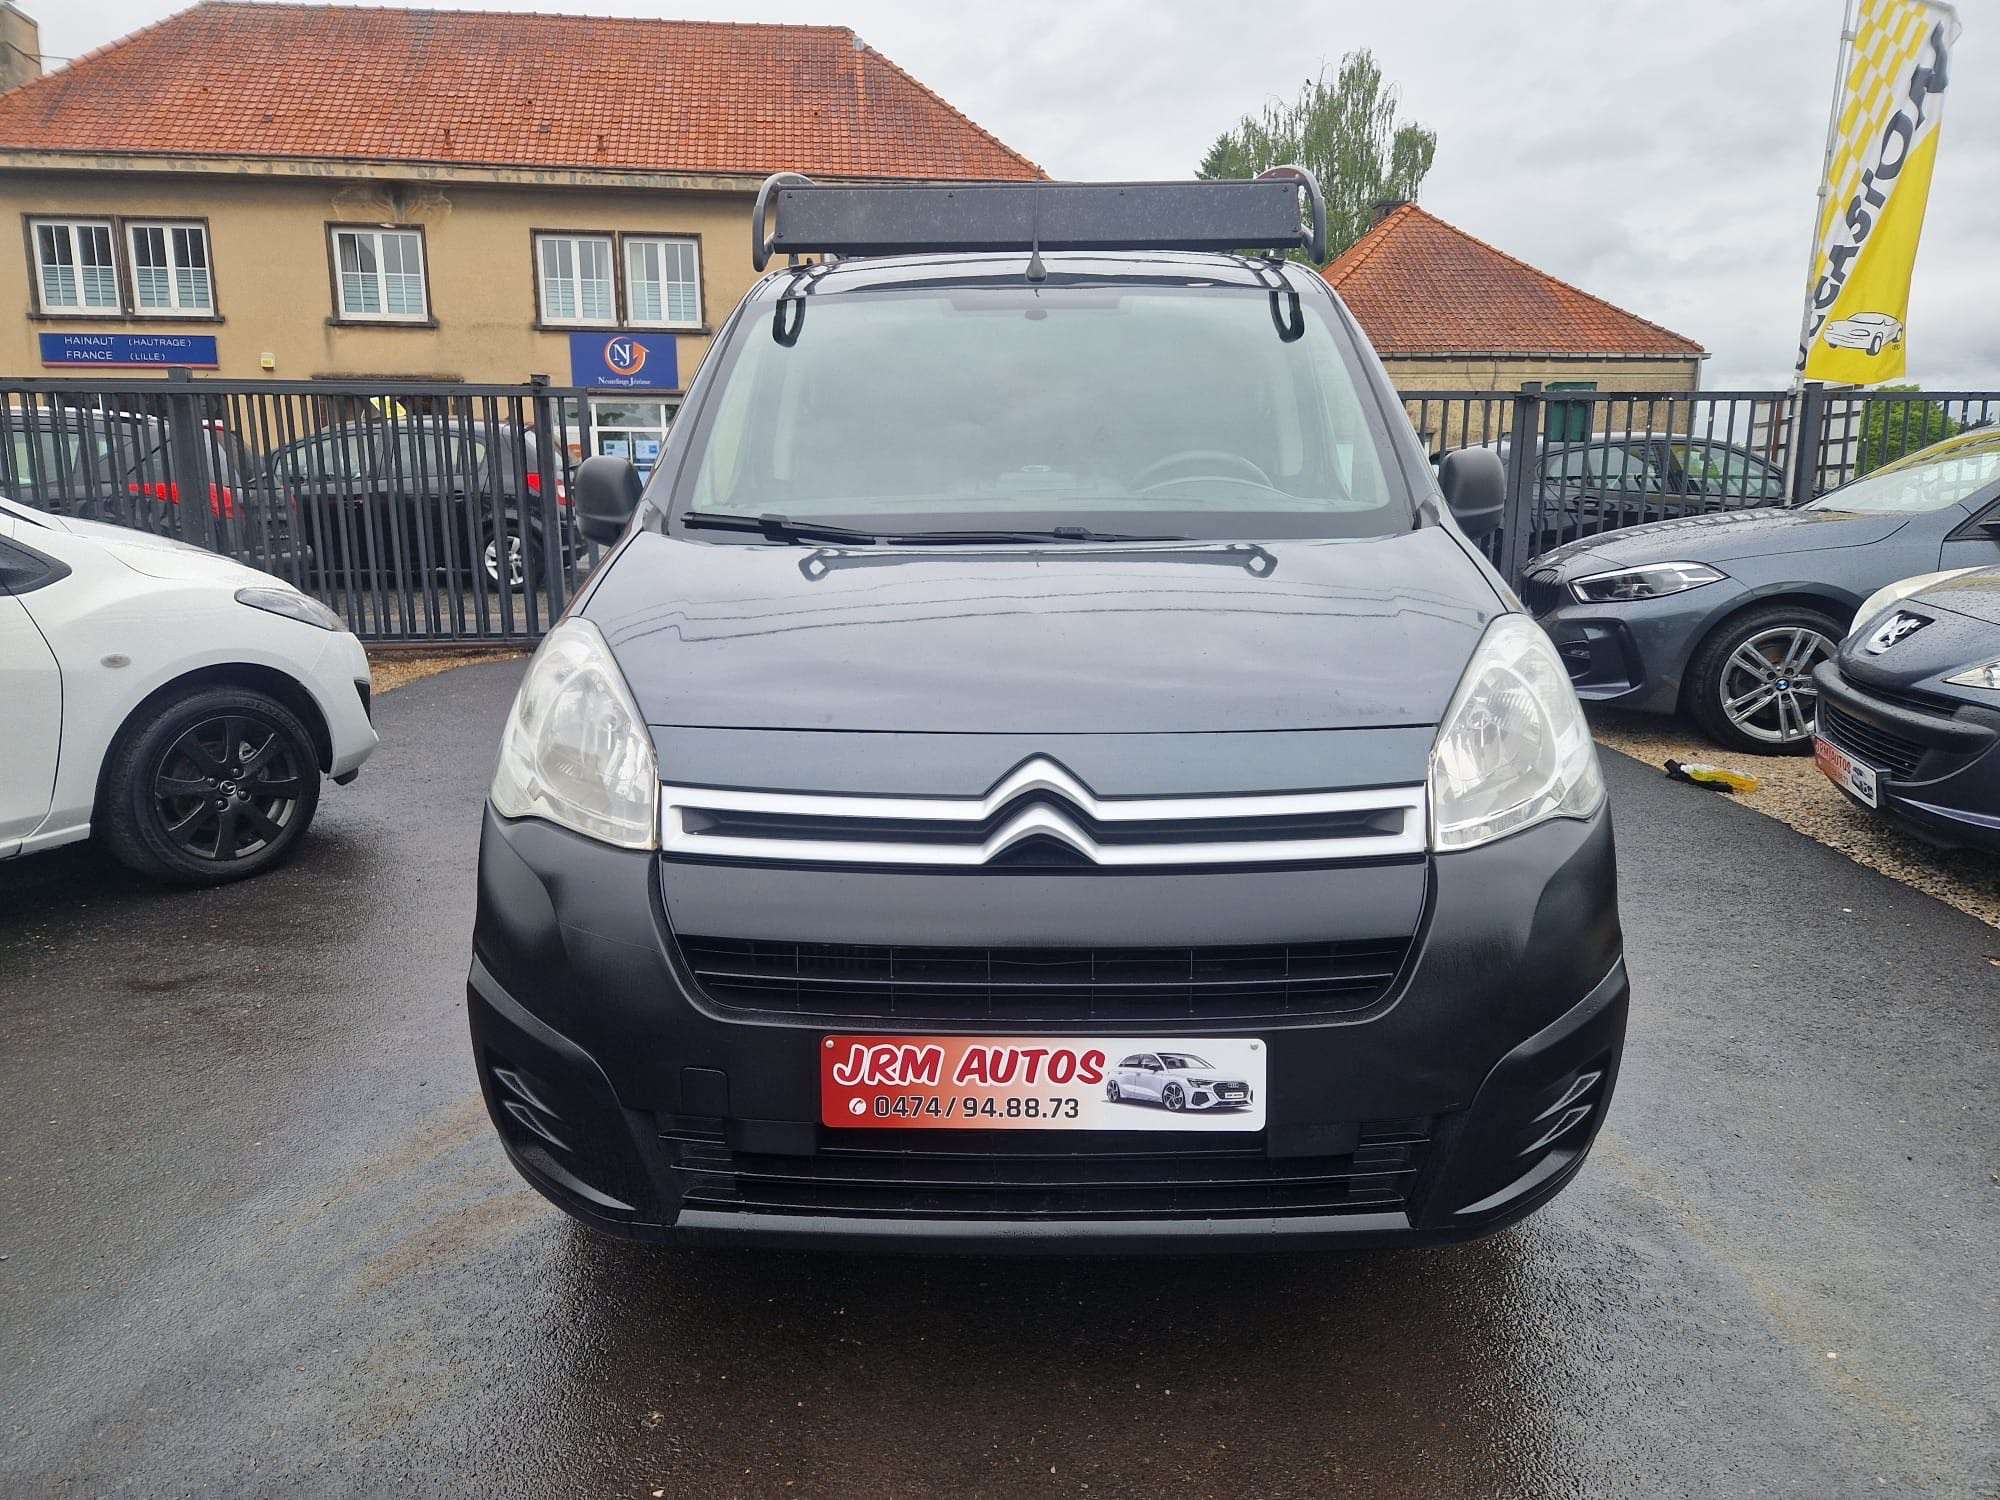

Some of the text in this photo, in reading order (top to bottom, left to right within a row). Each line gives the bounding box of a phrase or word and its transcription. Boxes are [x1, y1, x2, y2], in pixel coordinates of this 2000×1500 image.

[64, 335, 192, 347] HAINAUT (HAUTRAGE)
[66, 350, 166, 361] FRANCE (LILLE)
[613, 344, 631, 366] NJ
[833, 1044, 1105, 1086] JRM AUTOS
